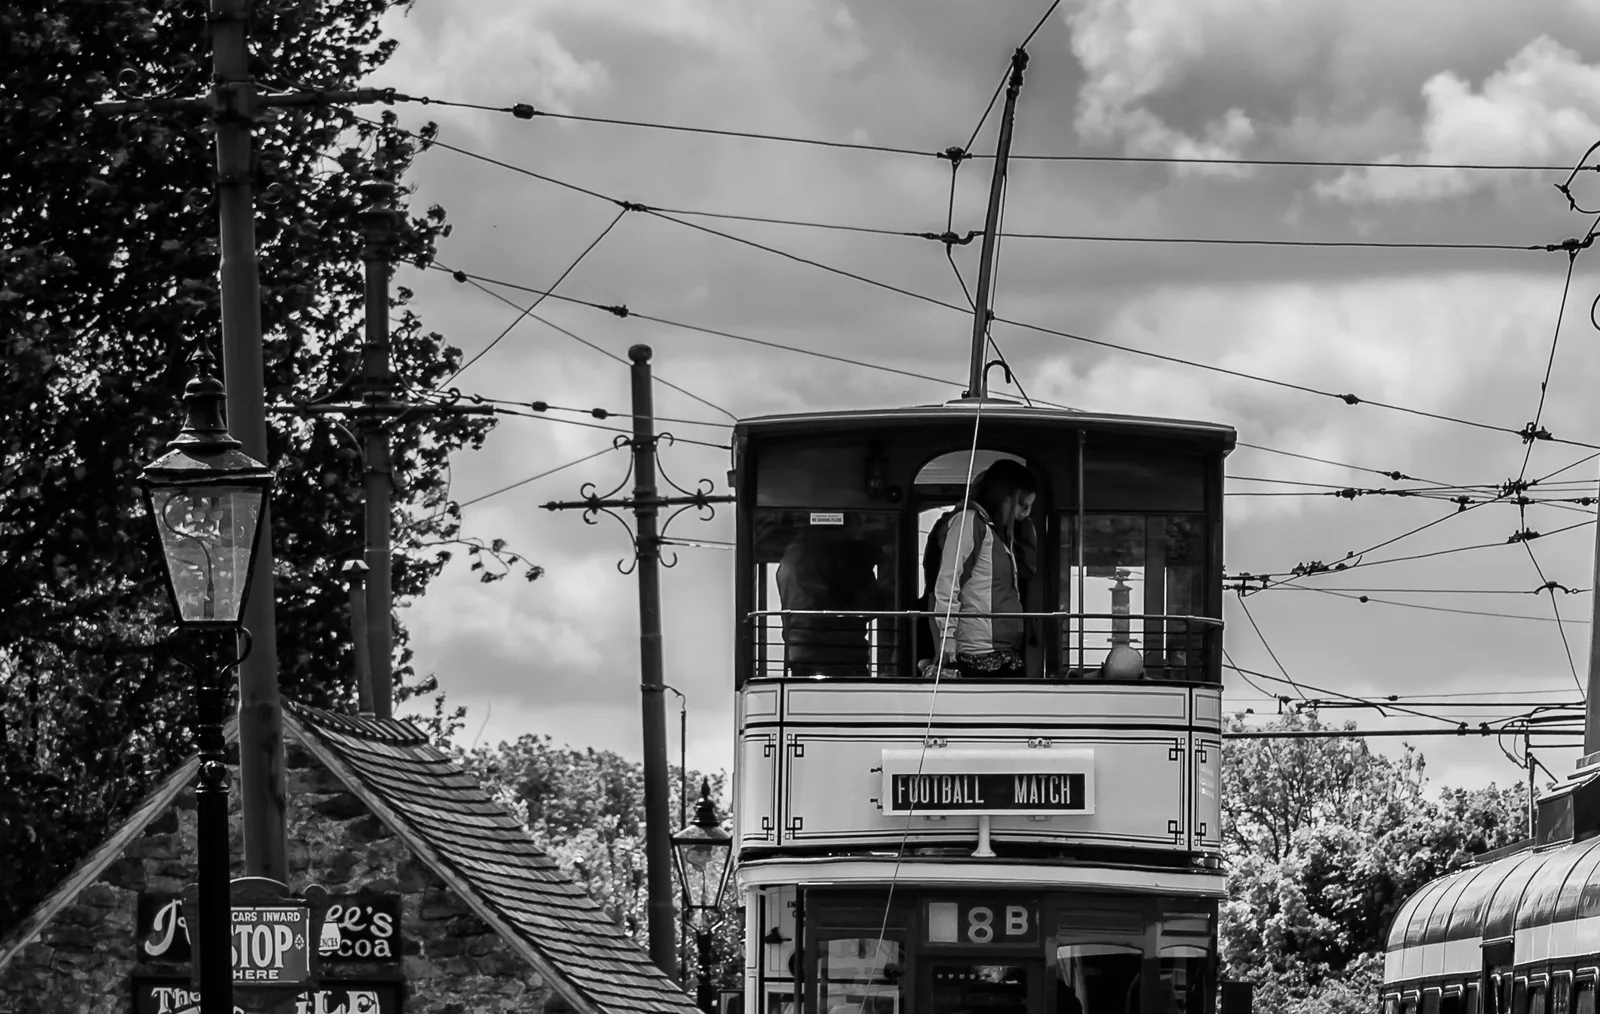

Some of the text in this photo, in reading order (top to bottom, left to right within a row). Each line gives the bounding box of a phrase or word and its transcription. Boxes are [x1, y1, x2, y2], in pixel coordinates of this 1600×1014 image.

[898, 775, 1071, 804] FOOTBALL MATCH
[231, 912, 301, 922] CARS INWARD
[967, 905, 1028, 944] 8 B
[232, 970, 279, 980] HERE
